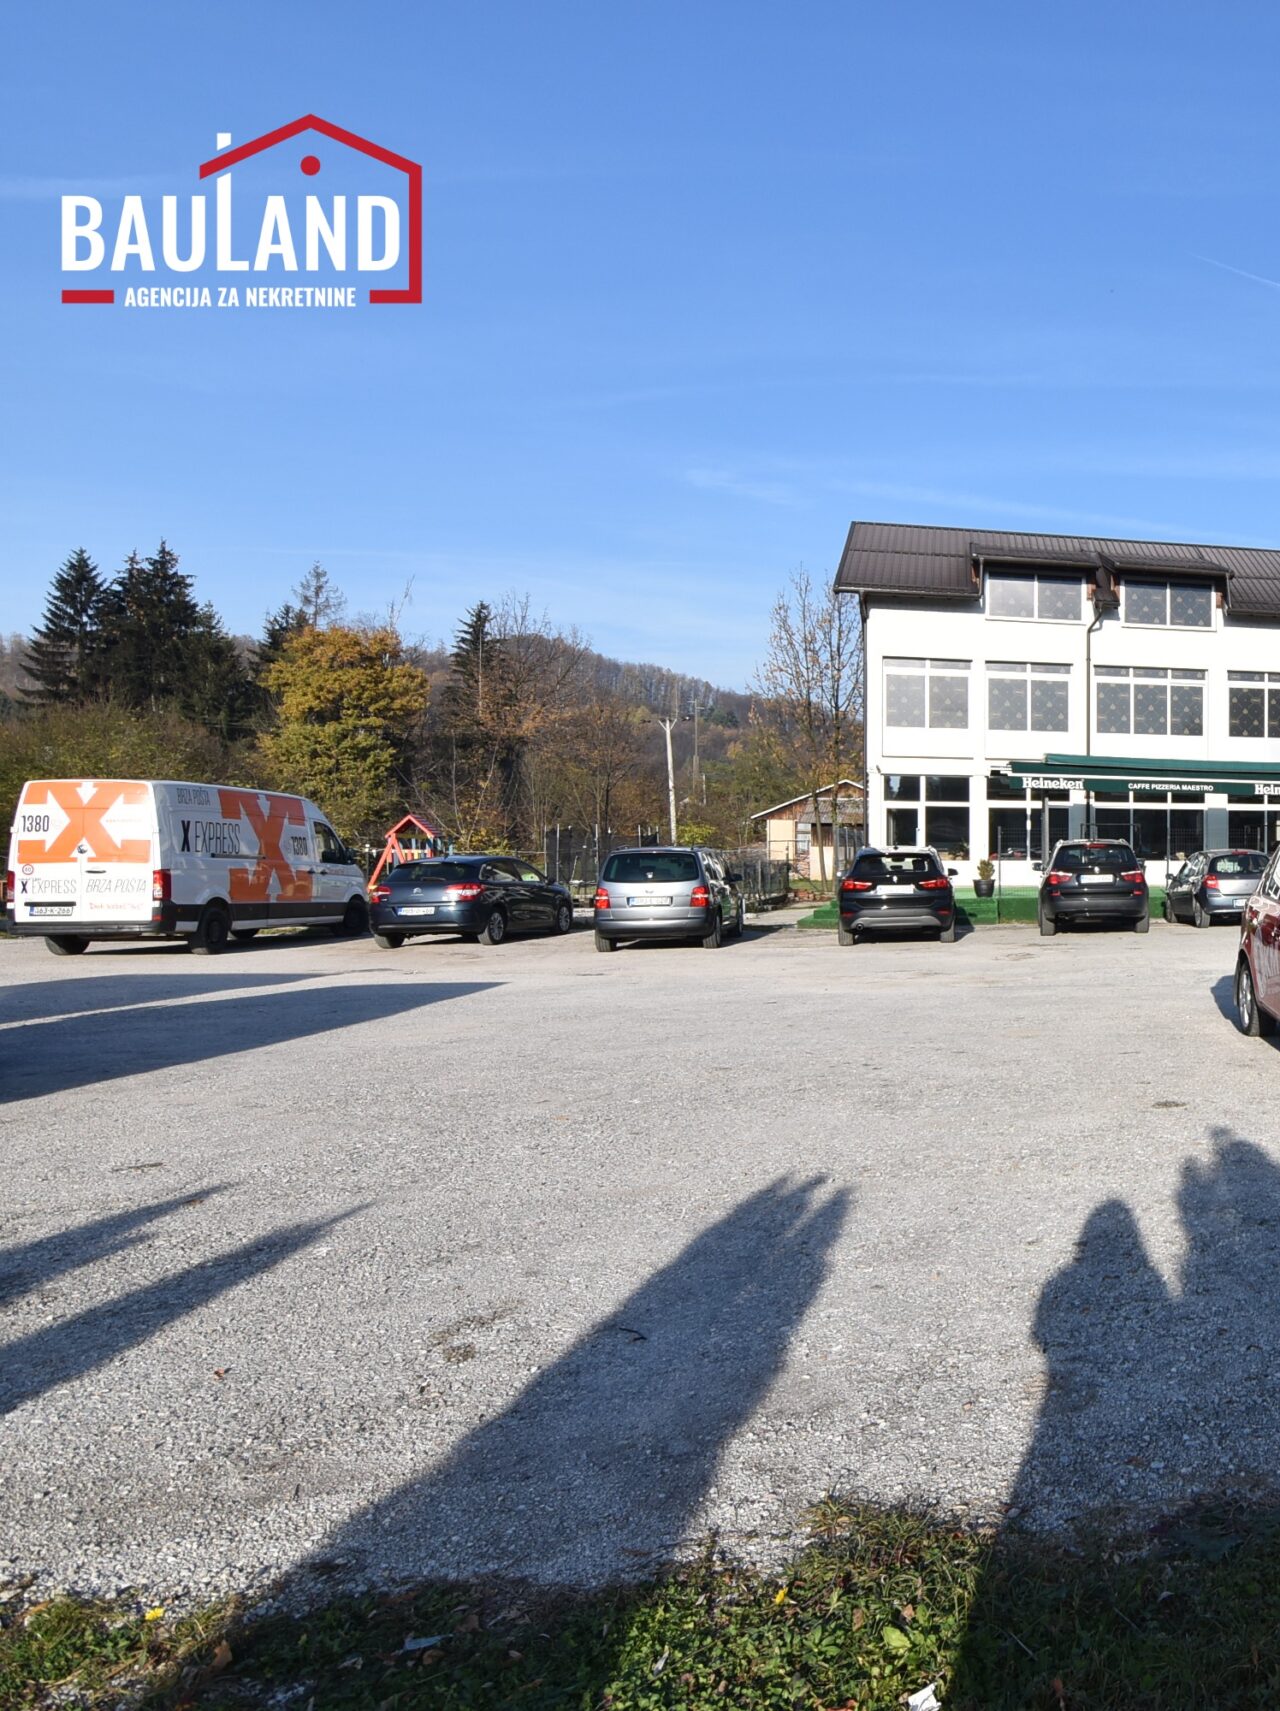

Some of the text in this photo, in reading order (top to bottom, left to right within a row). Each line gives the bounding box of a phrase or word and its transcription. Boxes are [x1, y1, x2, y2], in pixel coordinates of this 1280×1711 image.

[1022, 777, 1084, 789] Heineken
[1151, 783, 1181, 791] PIZZERIA
[1182, 784, 1214, 792] MAESTRO
[177, 788, 192, 804] BRZA
[22, 815, 50, 832] 1380
[181, 820, 241, 855] X EXPRESS
[290, 836, 308, 856] 1380
[20, 879, 77, 894] X EXPRESS
[86, 879, 112, 893] BRZA
